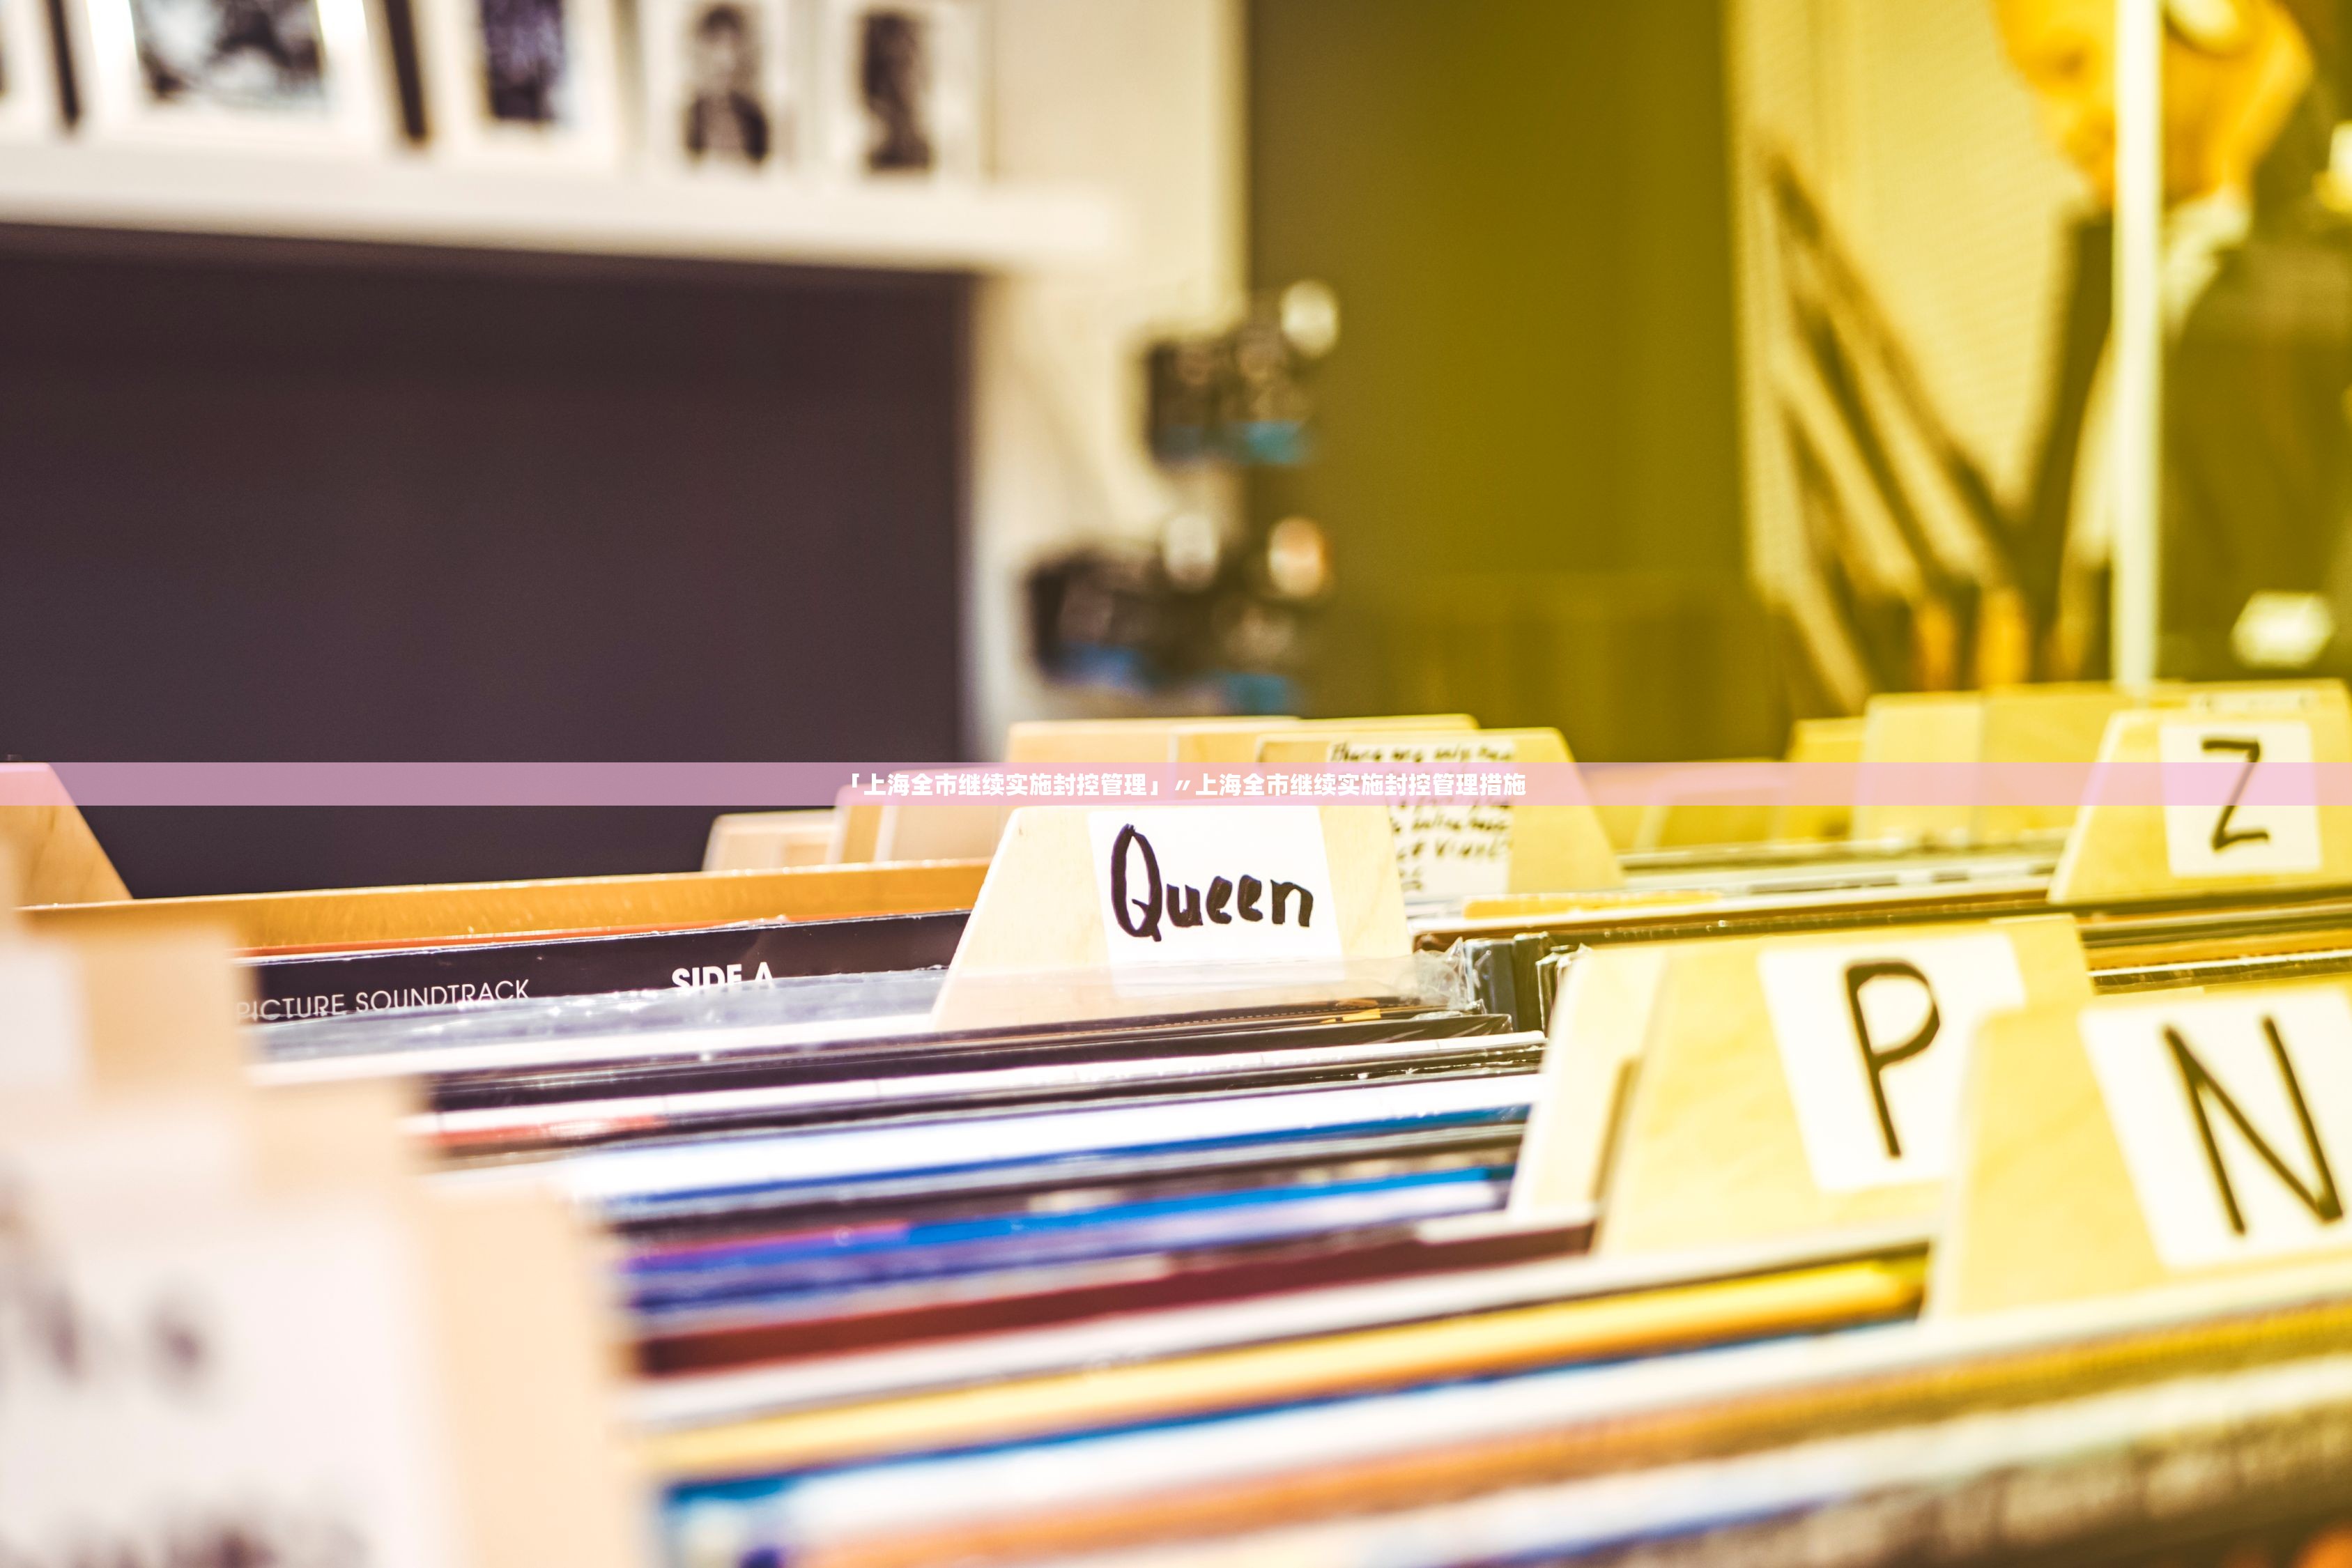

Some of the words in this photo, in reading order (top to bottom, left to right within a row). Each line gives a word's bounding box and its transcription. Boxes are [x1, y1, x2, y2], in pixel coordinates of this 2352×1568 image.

[2201, 739, 2270, 852] Z
[1111, 824, 1314, 943] Queen
[236, 993, 346, 1022] PICTURE
[355, 978, 530, 1013] SOUNDTRACK
[672, 964, 742, 987] SIDE
[754, 962, 774, 986] A
[1844, 960, 1941, 1158] P
[2163, 1016, 2344, 1235] N
